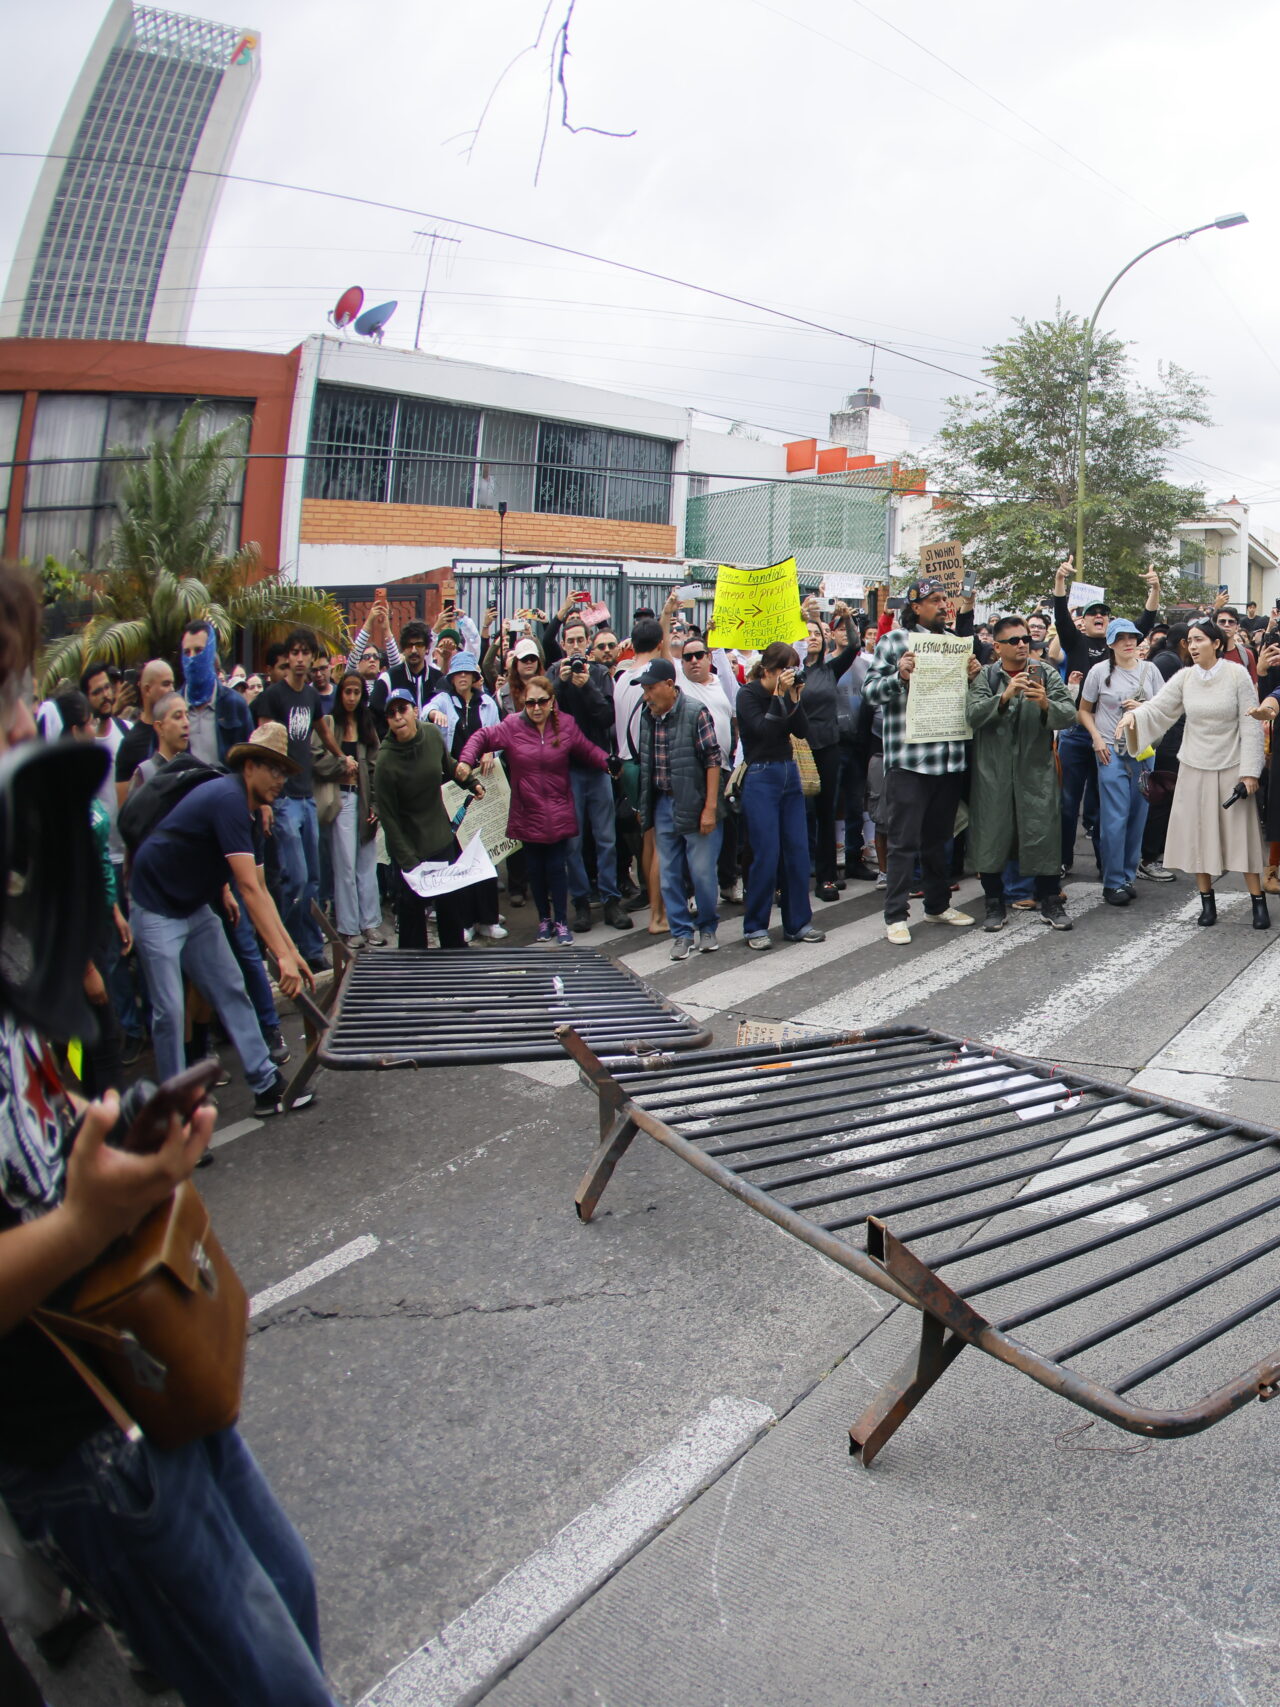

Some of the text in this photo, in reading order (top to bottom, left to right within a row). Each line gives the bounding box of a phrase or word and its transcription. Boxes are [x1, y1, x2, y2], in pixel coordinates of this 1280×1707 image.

[926, 545, 956, 561] SI NO HAY
[943, 571, 956, 581] QUE
[914, 642, 921, 653] AL
[922, 641, 941, 654] ESTILO
